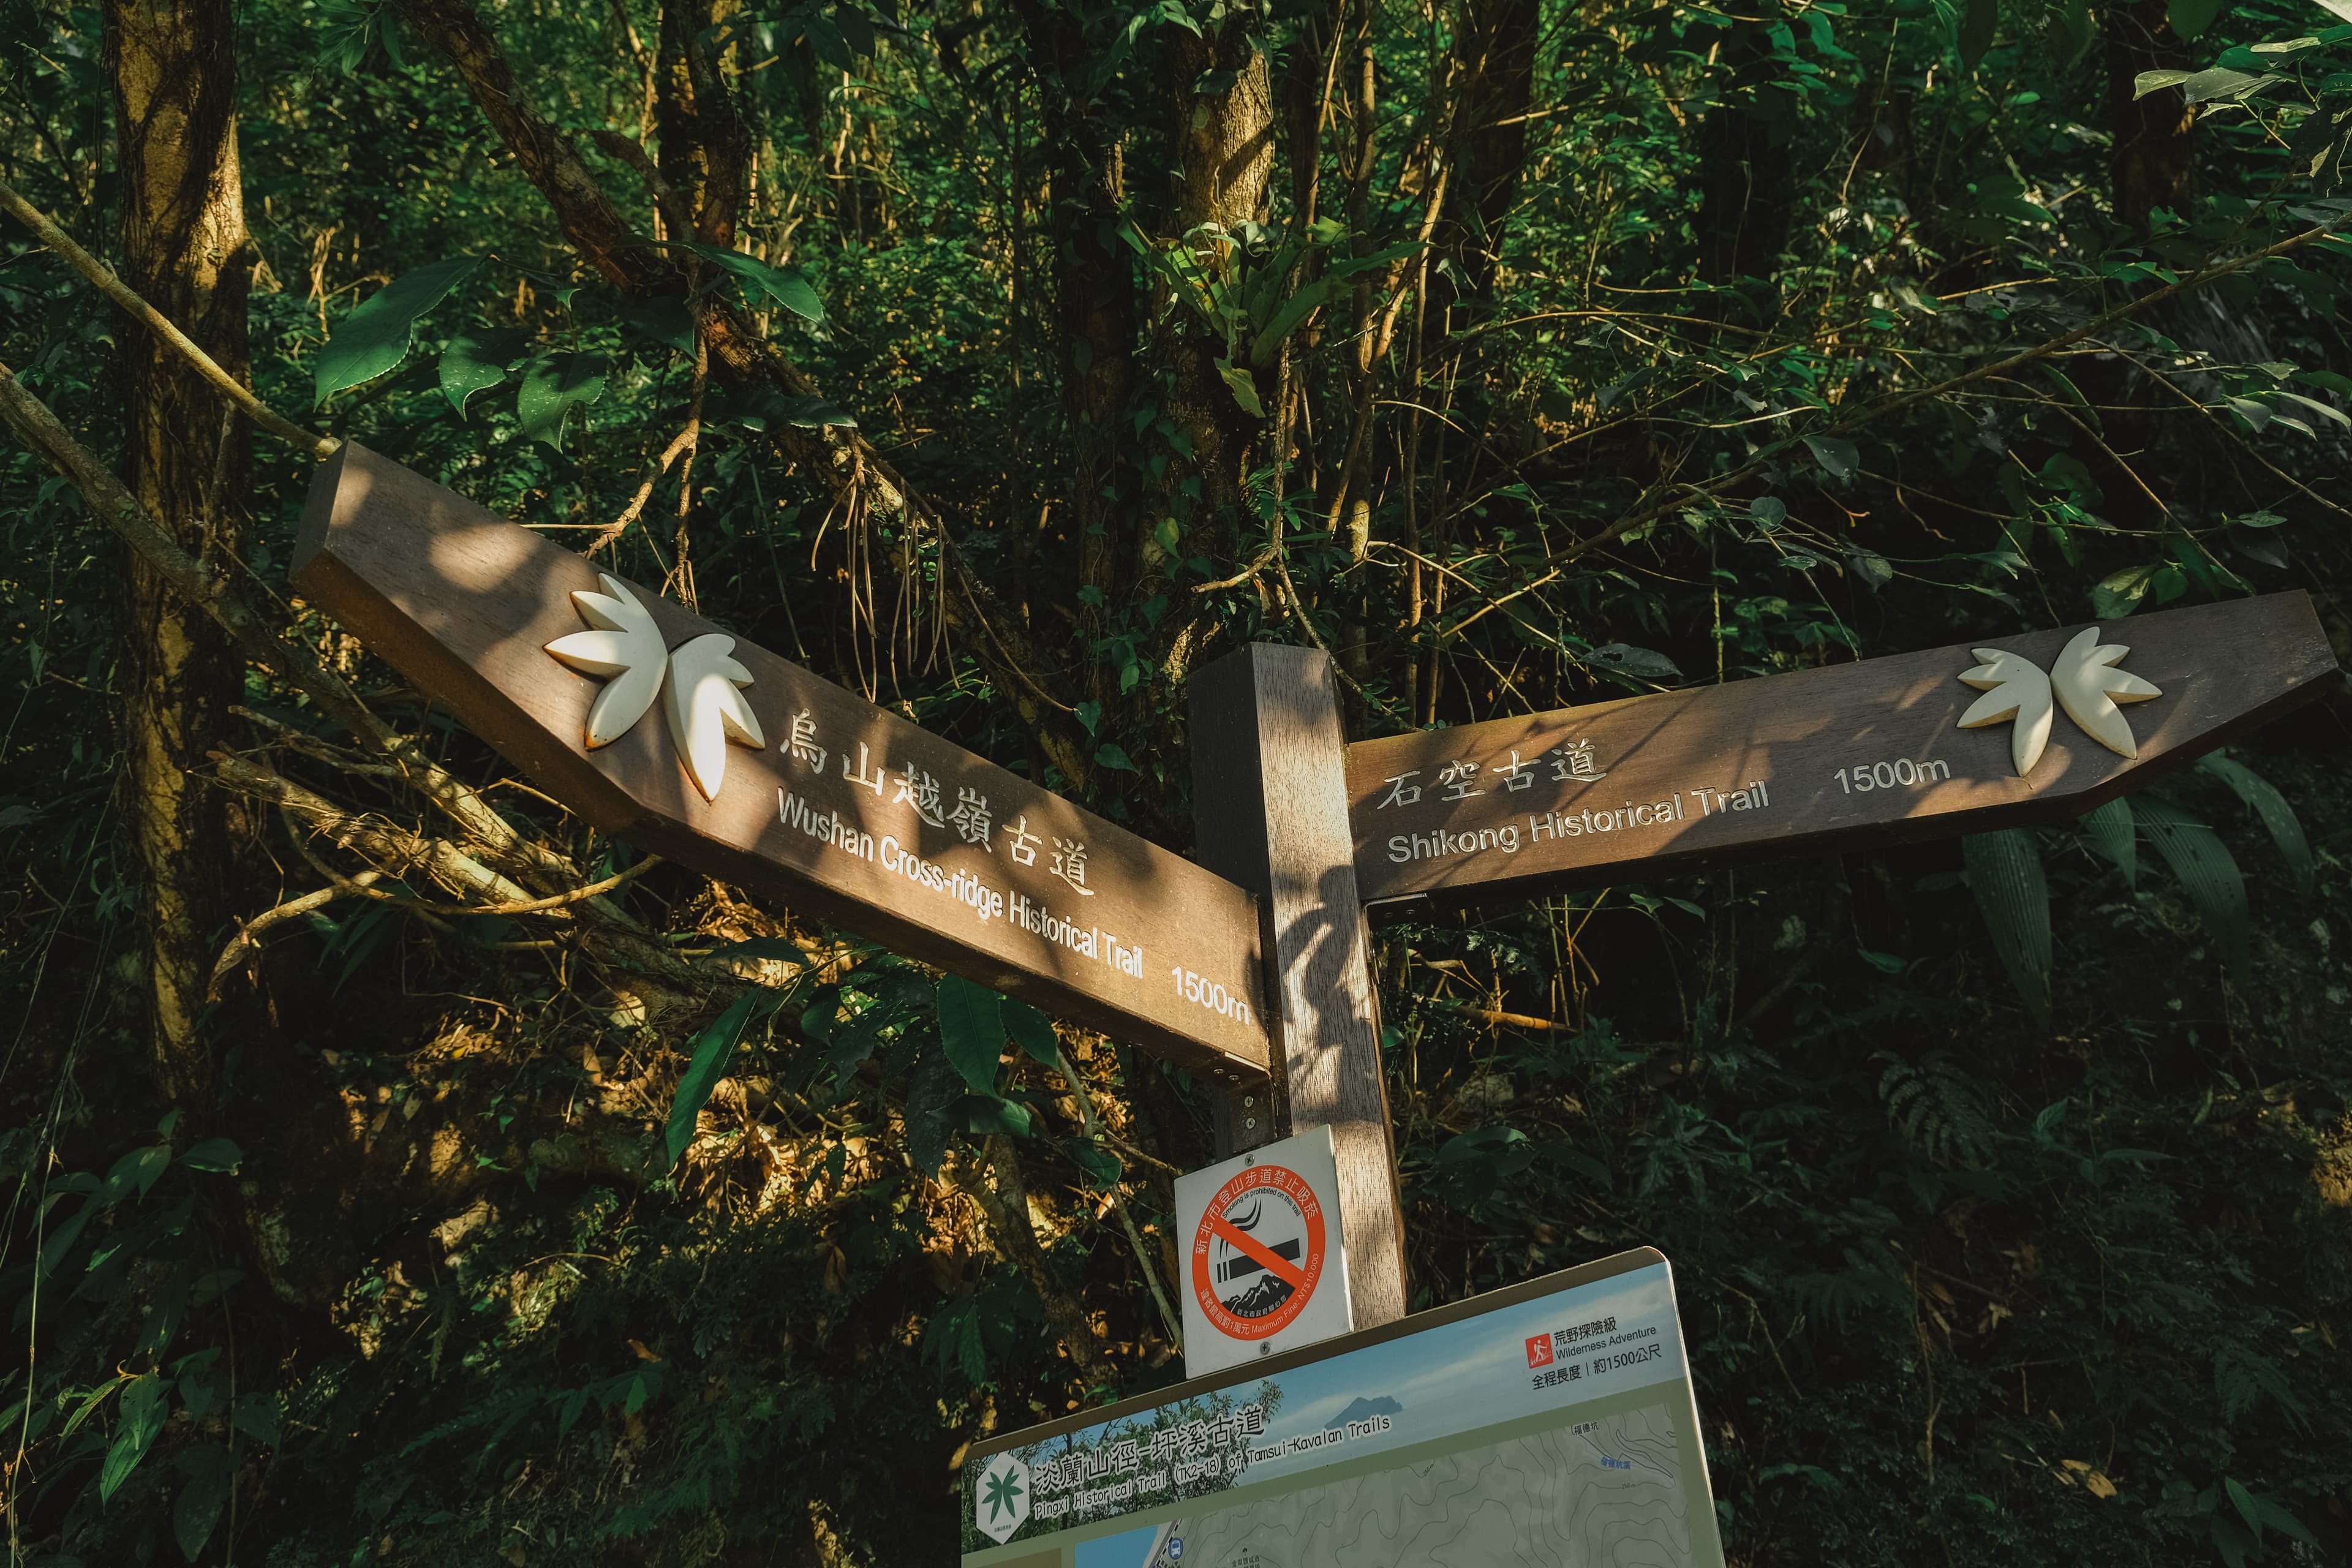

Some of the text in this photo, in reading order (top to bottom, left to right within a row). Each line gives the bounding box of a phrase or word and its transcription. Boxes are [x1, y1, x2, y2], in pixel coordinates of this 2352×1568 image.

[780, 707, 1095, 896] 烏山越嶺古道
[1377, 738, 1608, 810] 石空古道
[1388, 758, 1951, 864] Shikong Historical Trail 1500m
[778, 786, 1250, 1025] Wushan Cross-ridge Historical Trail 1500m
[1222, 1196, 1244, 1218] Smoking
[1250, 1187, 1277, 1197] prohibited
[1284, 1195, 1293, 1207] this
[1292, 1204, 1302, 1217] trail
[1251, 1315, 1284, 1333] Maximum
[1553, 1316, 1617, 1347] 荒野探險級
[1556, 1326, 1656, 1360] Wilderness Adventure
[1035, 1416, 1390, 1518] Pingxi Historical Trail (TK2-18) of Tamsui-Kavalan Trails
